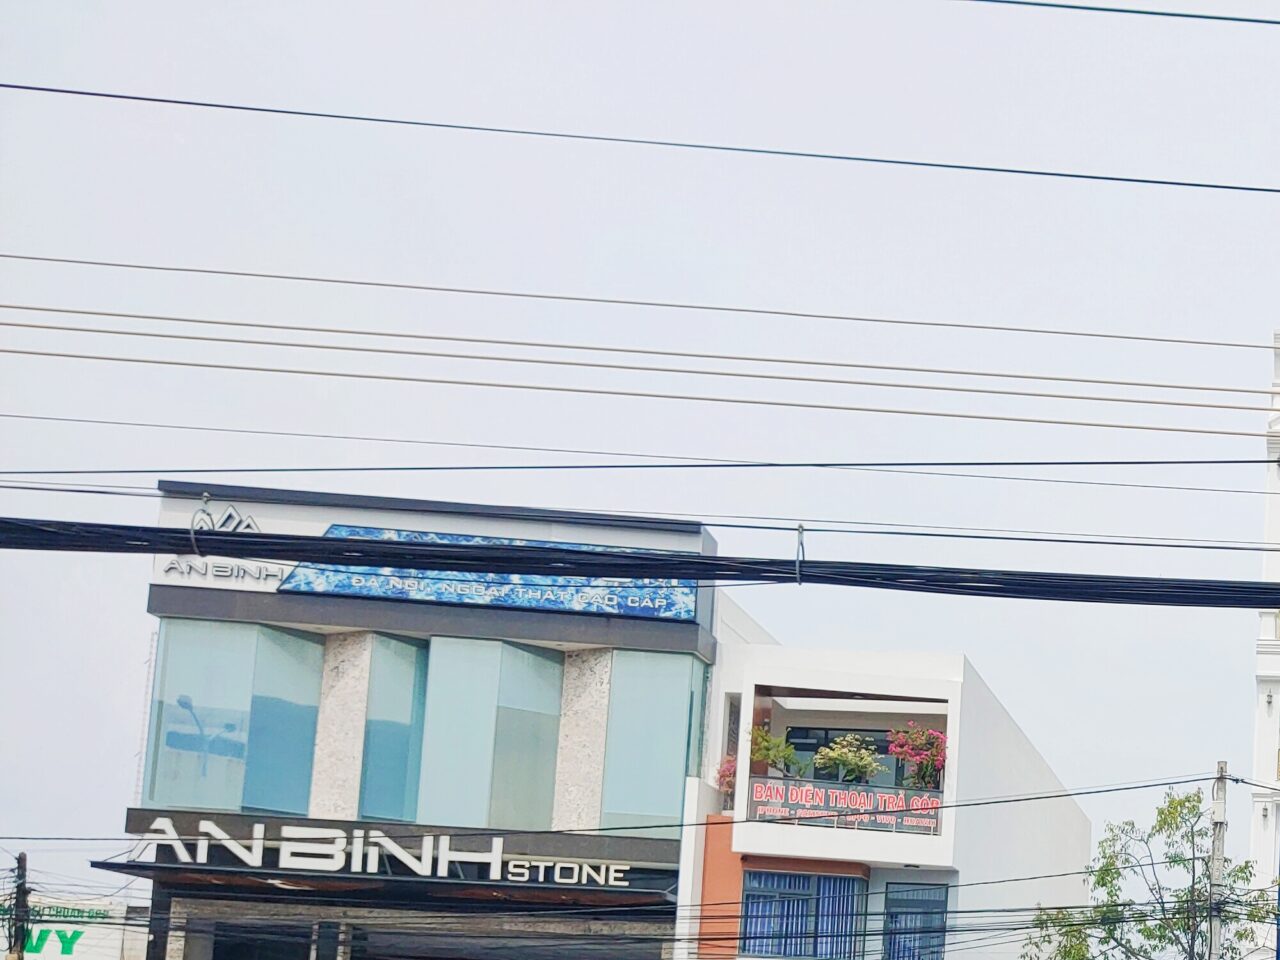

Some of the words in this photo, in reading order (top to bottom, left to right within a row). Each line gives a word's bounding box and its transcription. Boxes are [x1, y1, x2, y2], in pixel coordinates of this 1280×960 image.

[164, 559, 207, 577] AN
[754, 781, 786, 803] BÁN
[788, 783, 826, 808] ĐIỆN
[828, 789, 874, 812] THOẠI
[877, 790, 906, 811] TRẢ
[910, 793, 940, 815] GÓP
[128, 817, 265, 867] AN
[279, 825, 504, 880] BINH
[507, 860, 631, 887] STONE
[25, 929, 85, 955] VY
